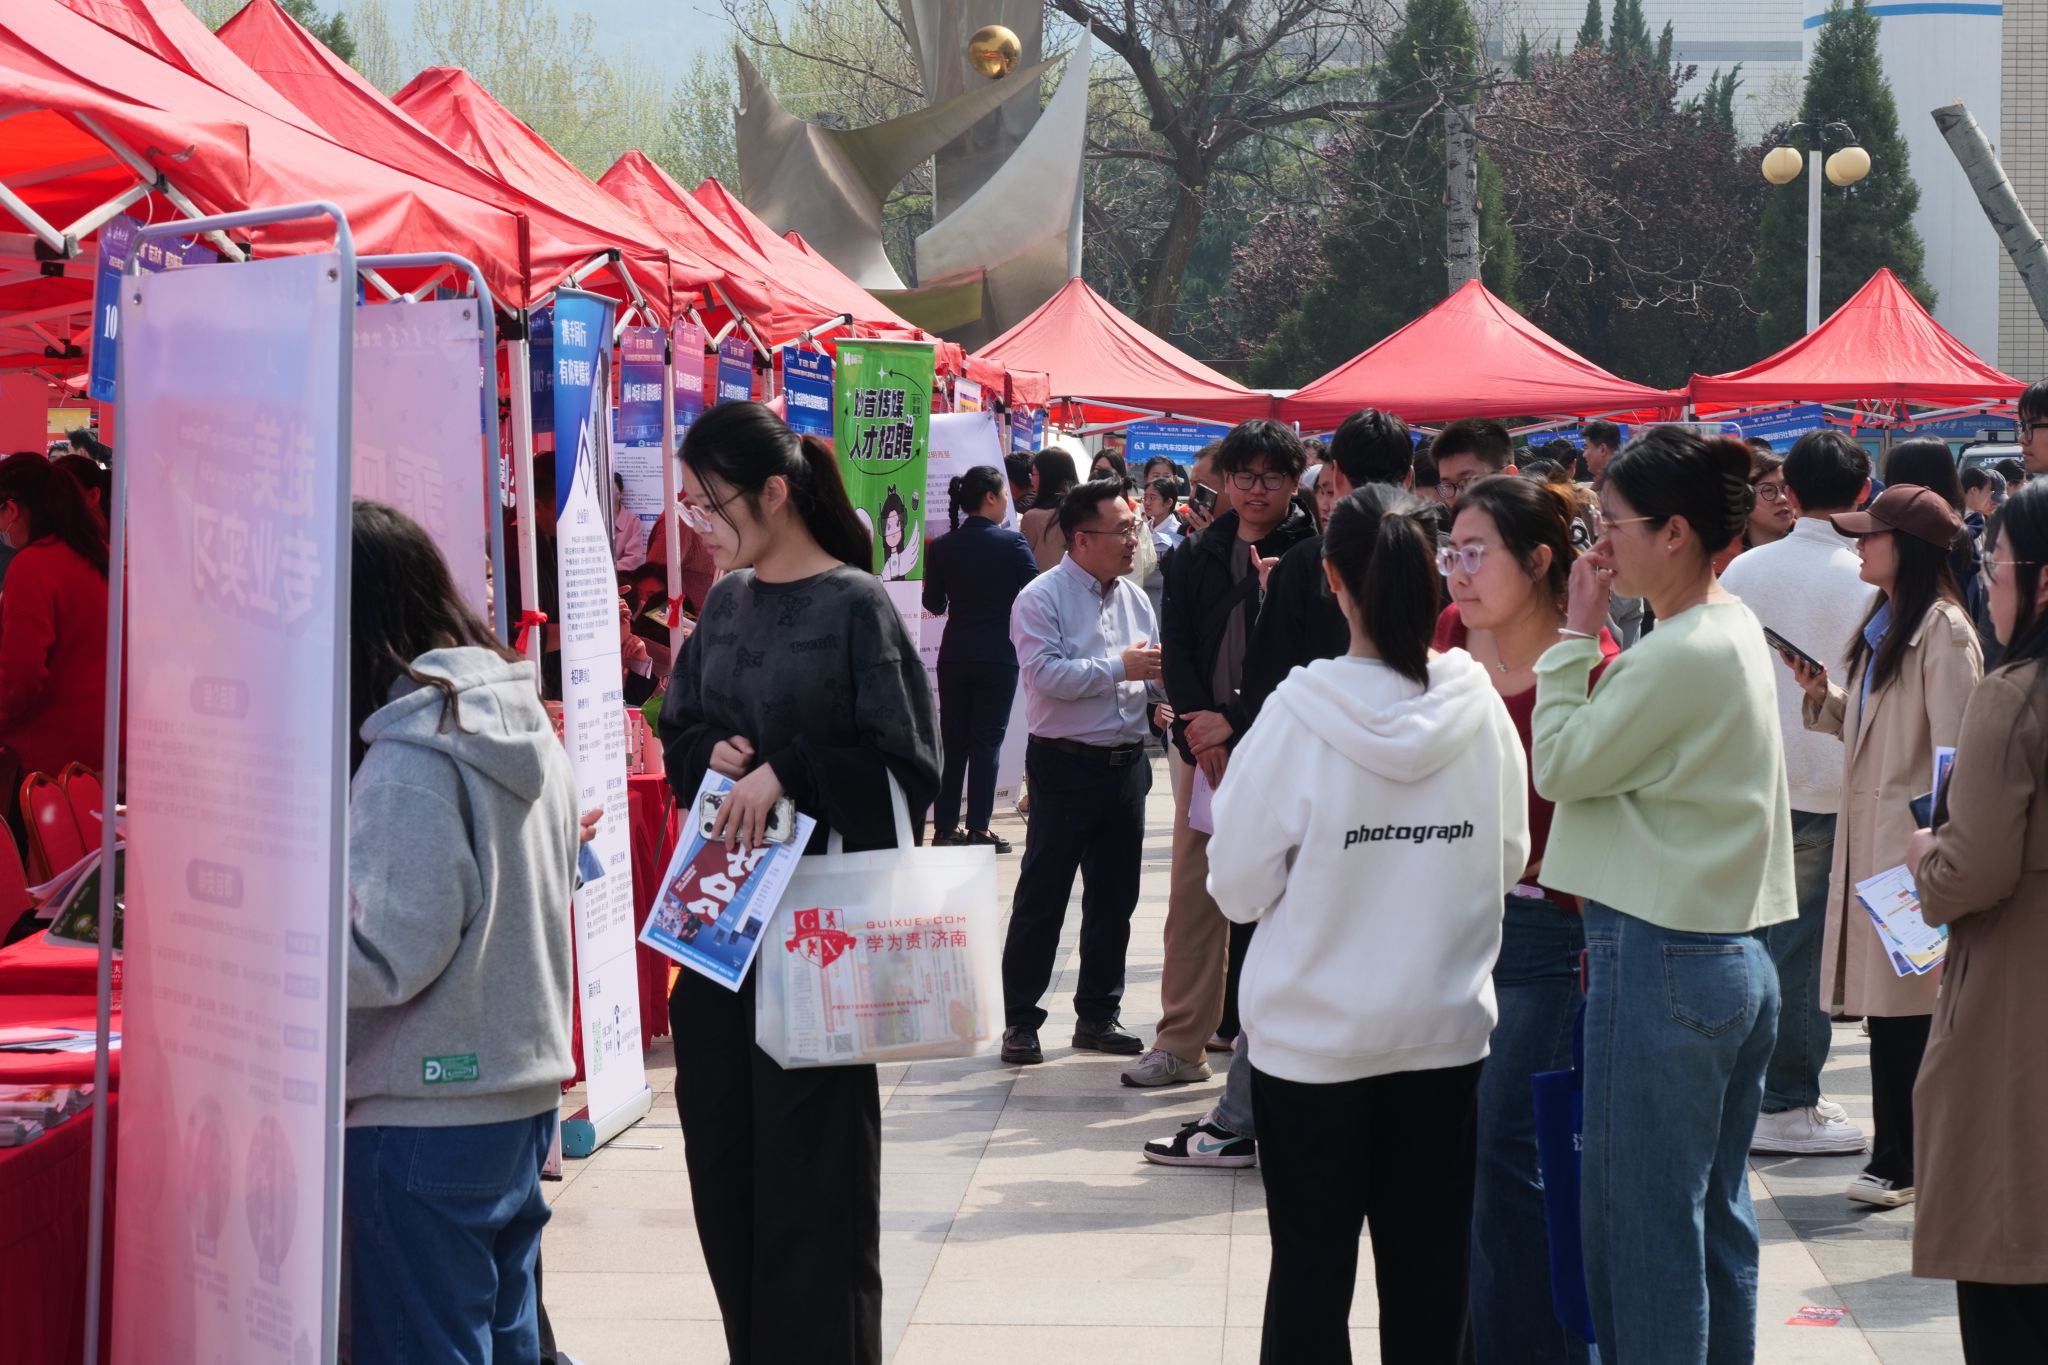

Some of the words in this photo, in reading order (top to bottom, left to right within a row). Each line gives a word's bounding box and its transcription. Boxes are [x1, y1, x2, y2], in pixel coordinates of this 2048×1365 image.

[849, 421, 914, 460] 人才招聘
[1133, 441, 1145, 450] 63
[1343, 820, 1474, 850] photograph
